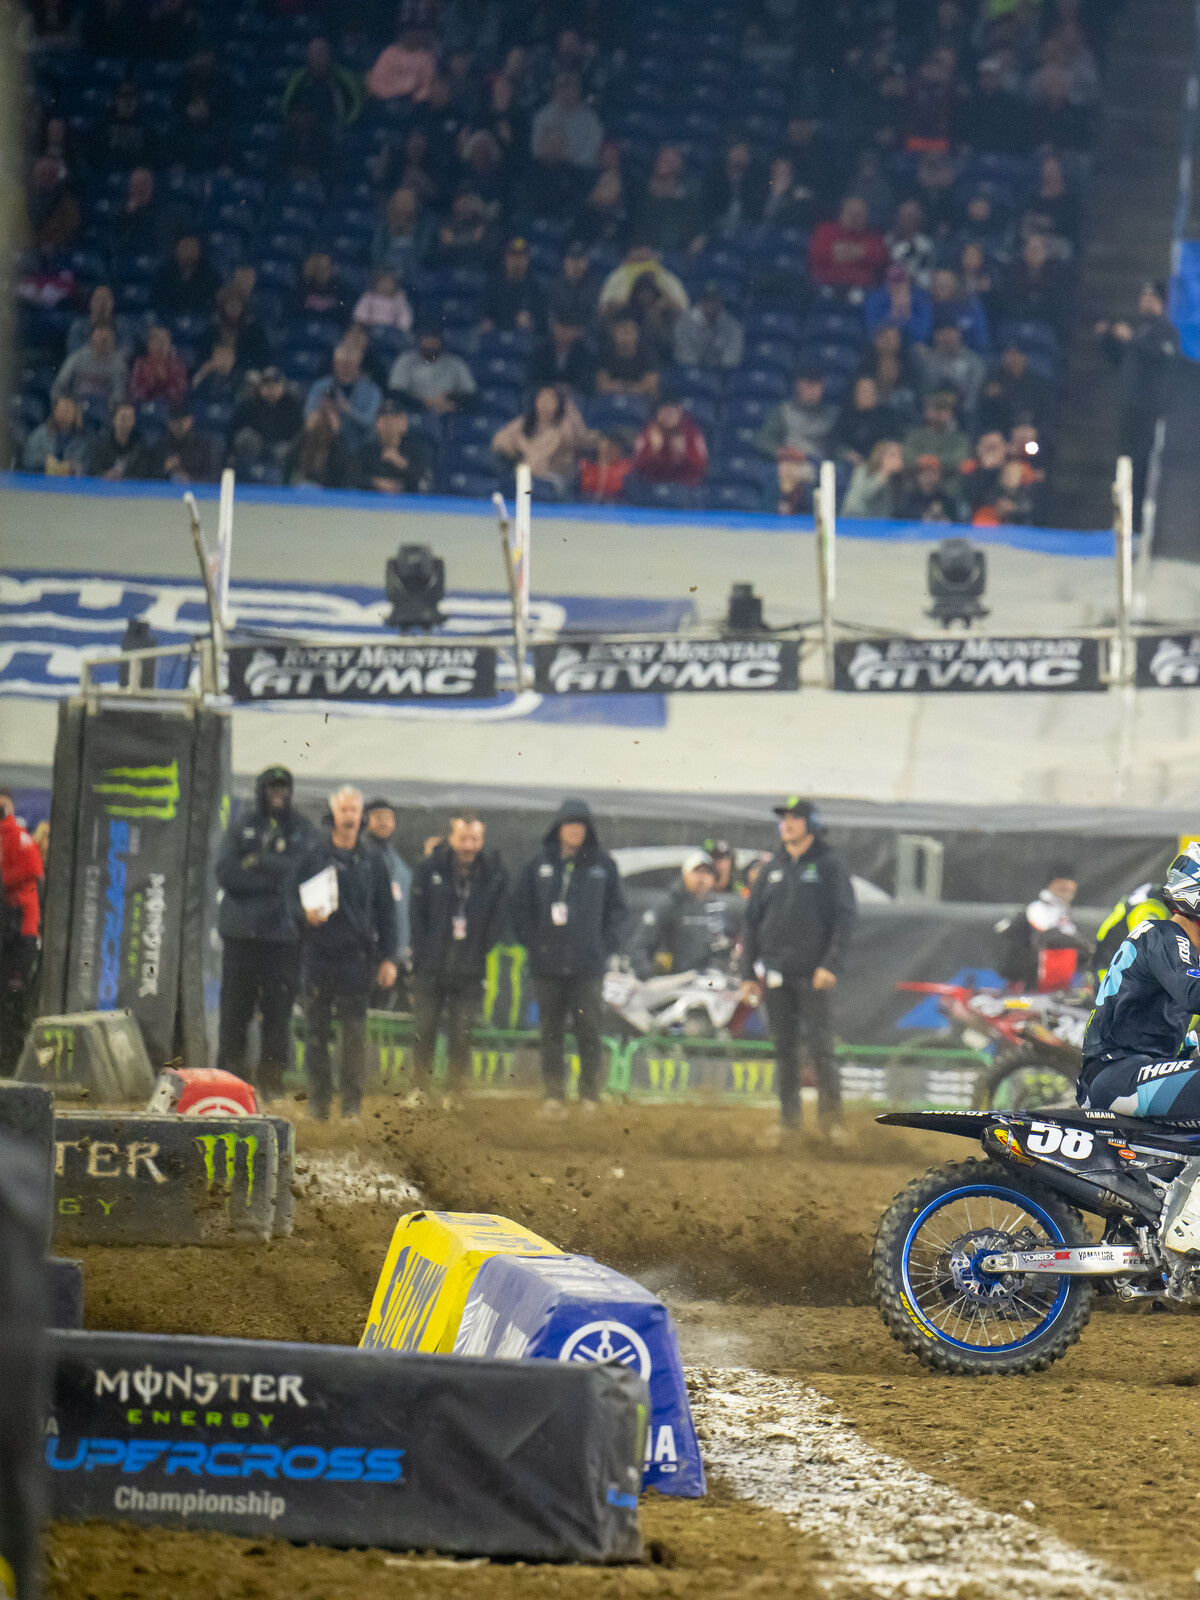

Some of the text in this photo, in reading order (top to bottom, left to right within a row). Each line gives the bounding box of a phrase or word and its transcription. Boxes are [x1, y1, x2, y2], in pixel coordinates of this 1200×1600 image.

[358, 645, 478, 668] MOUNTAIN
[661, 640, 782, 662] MOUNTAIN
[961, 638, 1082, 660] MOUNTAIN
[1137, 1060, 1194, 1083] THOR
[1084, 1111, 1116, 1120] YAMAHA
[1027, 1121, 1095, 1160] 58
[1021, 1252, 1056, 1263] VORTEX
[95, 1364, 309, 1408] MONSTER
[127, 1409, 275, 1432] ENERGY
[114, 1485, 286, 1520] Championship
